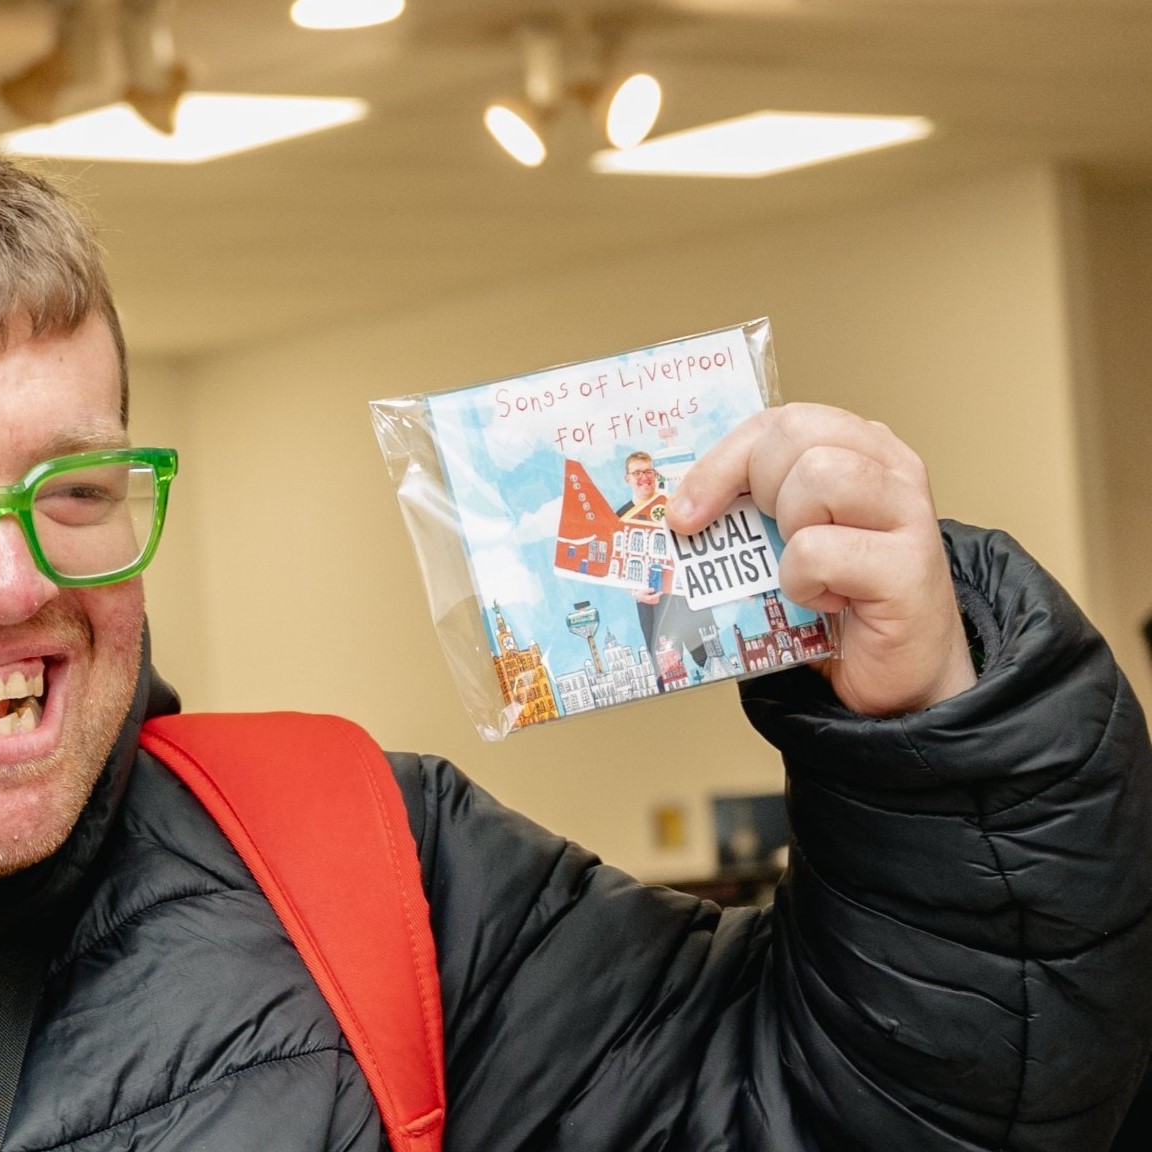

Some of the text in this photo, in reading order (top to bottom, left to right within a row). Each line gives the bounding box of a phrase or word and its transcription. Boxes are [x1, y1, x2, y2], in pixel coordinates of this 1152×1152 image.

[496, 382, 568, 418] Songs
[617, 346, 734, 390] Liverpool
[670, 510, 762, 561] LOCAL
[685, 546, 772, 598] ARTIST
